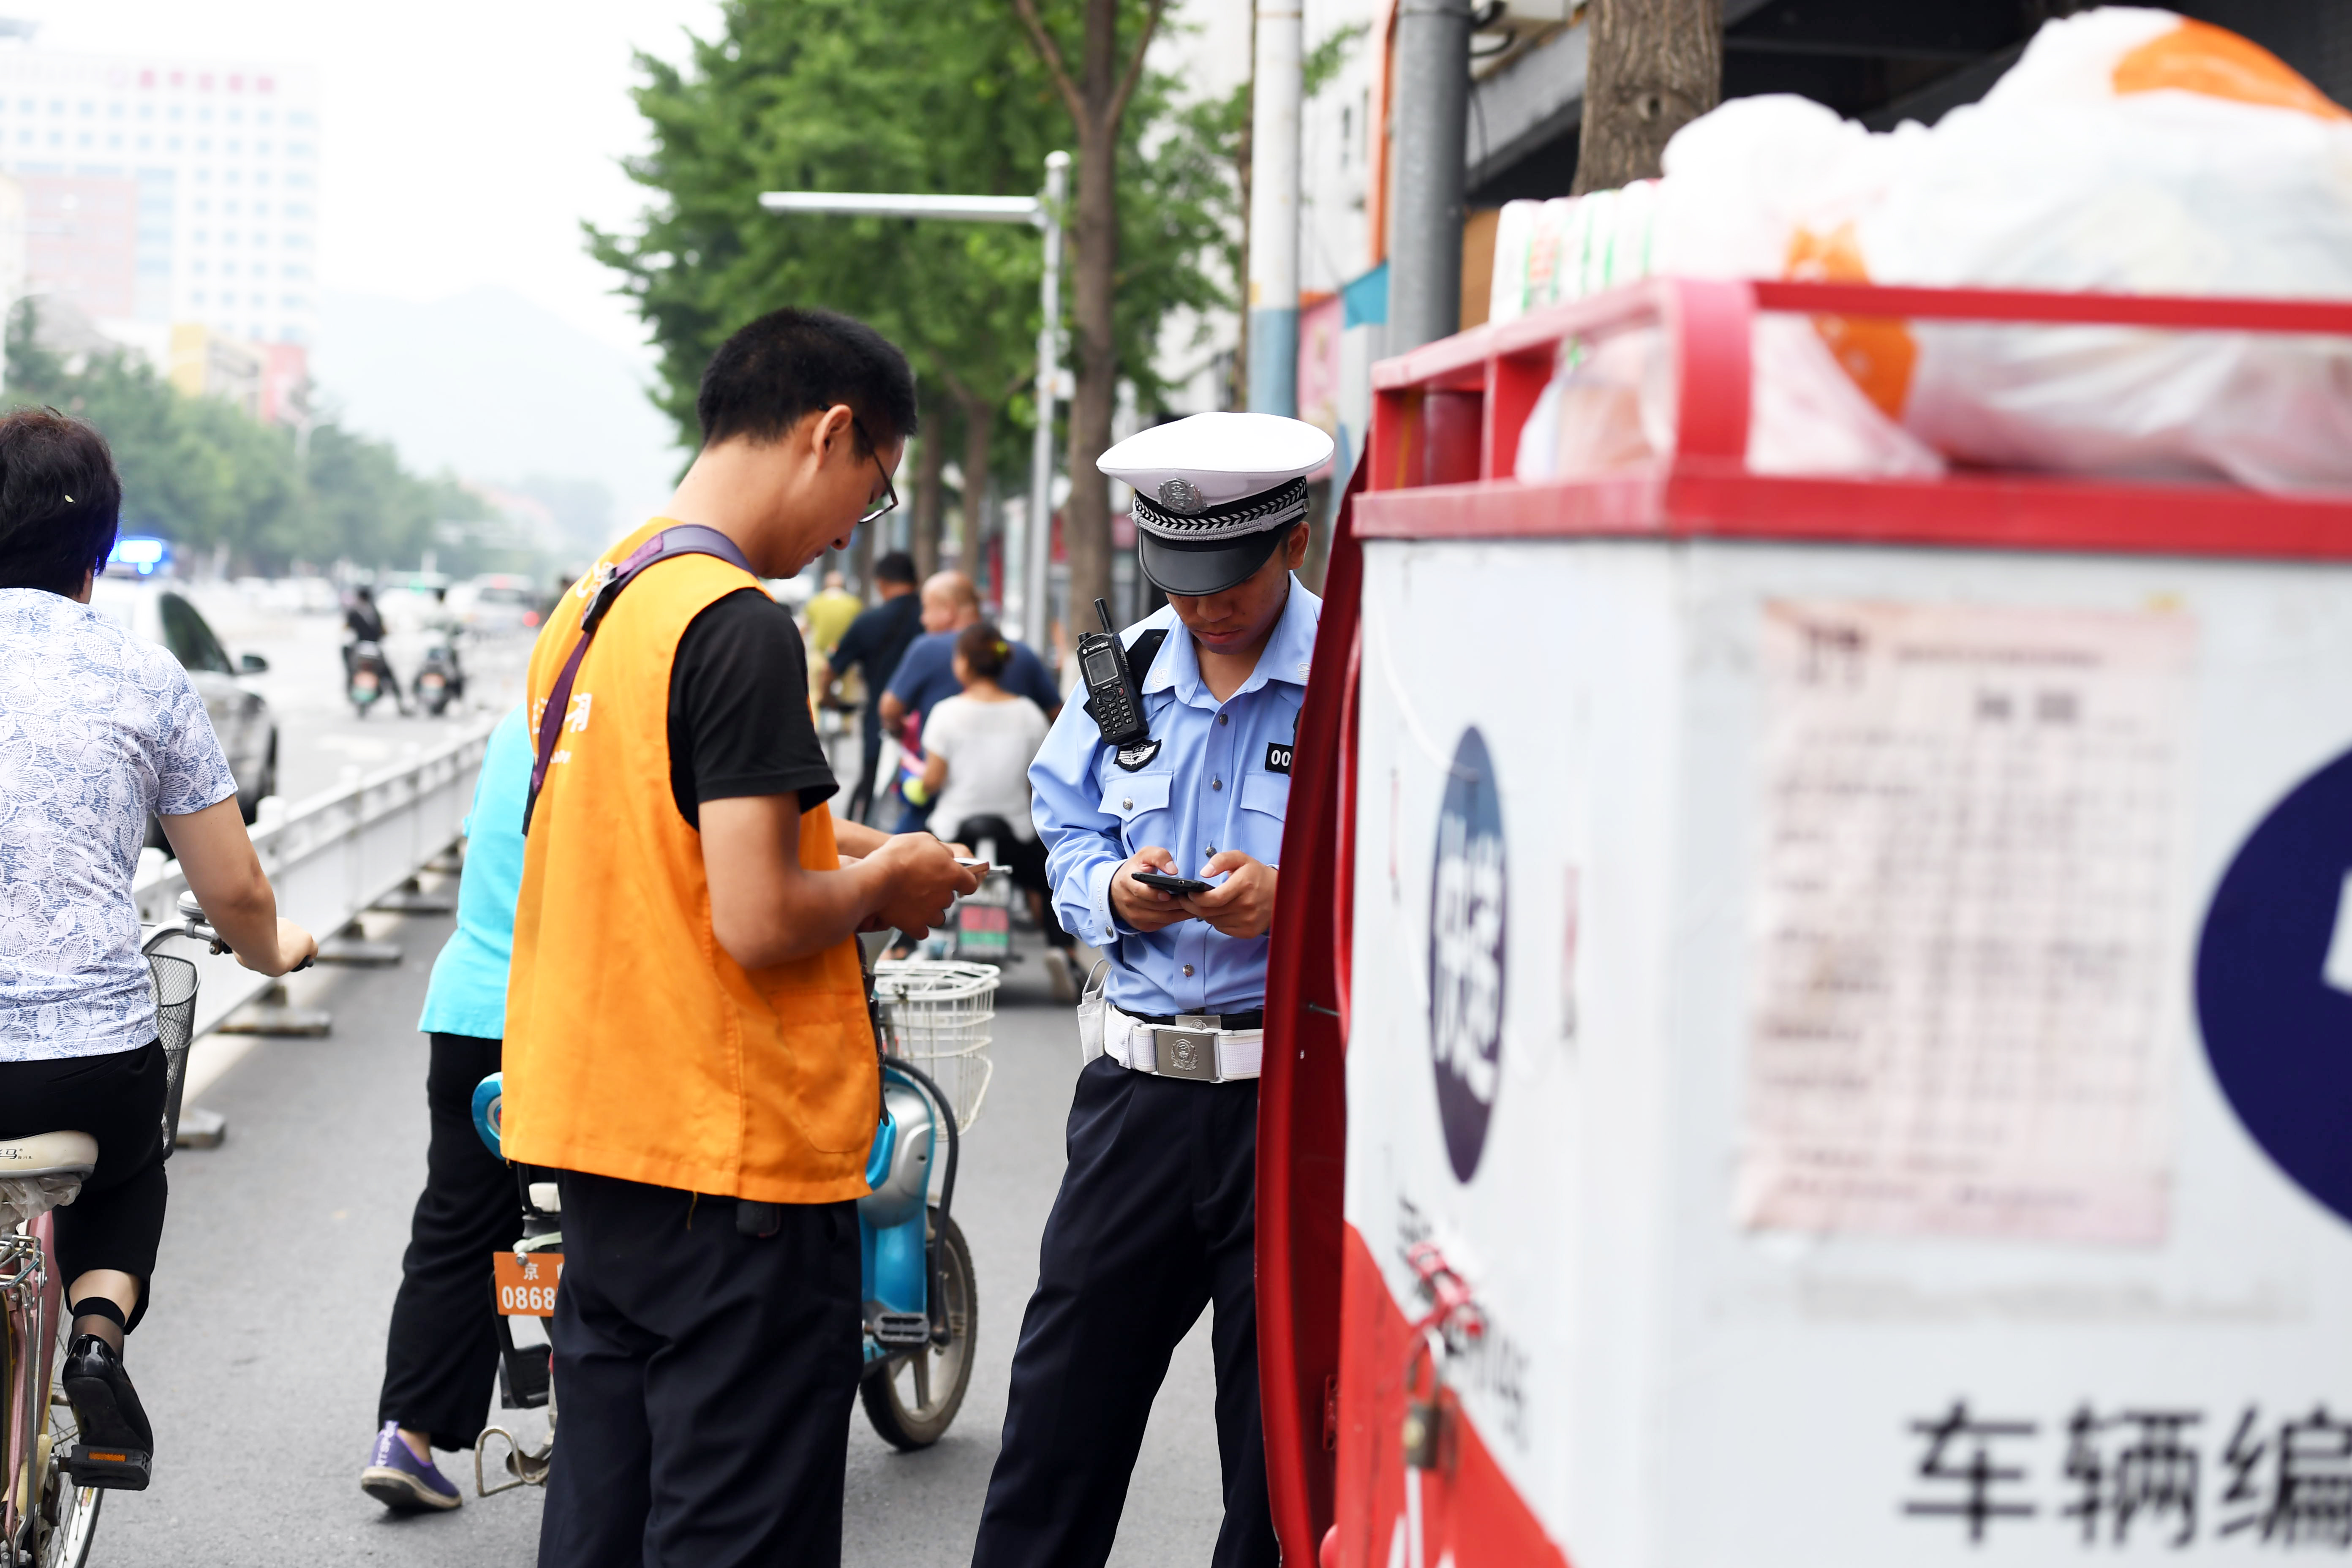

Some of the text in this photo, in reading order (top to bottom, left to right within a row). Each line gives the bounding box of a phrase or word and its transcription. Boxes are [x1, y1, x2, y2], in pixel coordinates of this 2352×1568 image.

[1088, 641, 1108, 651] MOTOROLA
[1271, 750, 1291, 767] 00
[502, 1286, 555, 1310] 0868
